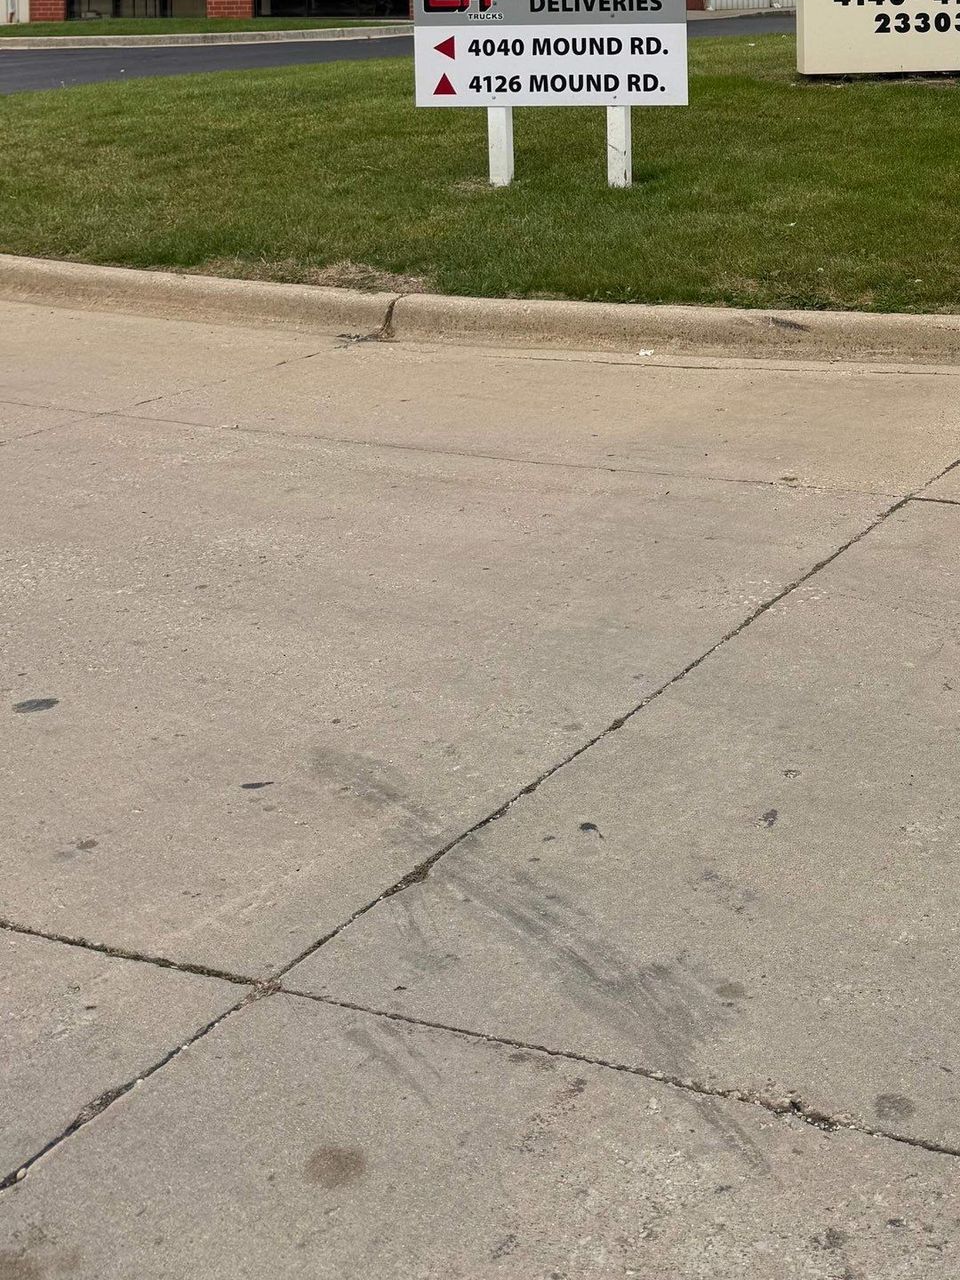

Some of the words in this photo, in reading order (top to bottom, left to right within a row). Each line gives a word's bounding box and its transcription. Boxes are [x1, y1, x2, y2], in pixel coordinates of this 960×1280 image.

[467, 38, 525, 57] 4040
[532, 36, 623, 56] MOUND
[630, 36, 669, 56] RD.
[468, 74, 522, 93] 4126
[529, 73, 620, 93] MOUND
[627, 73, 666, 93] RD.
